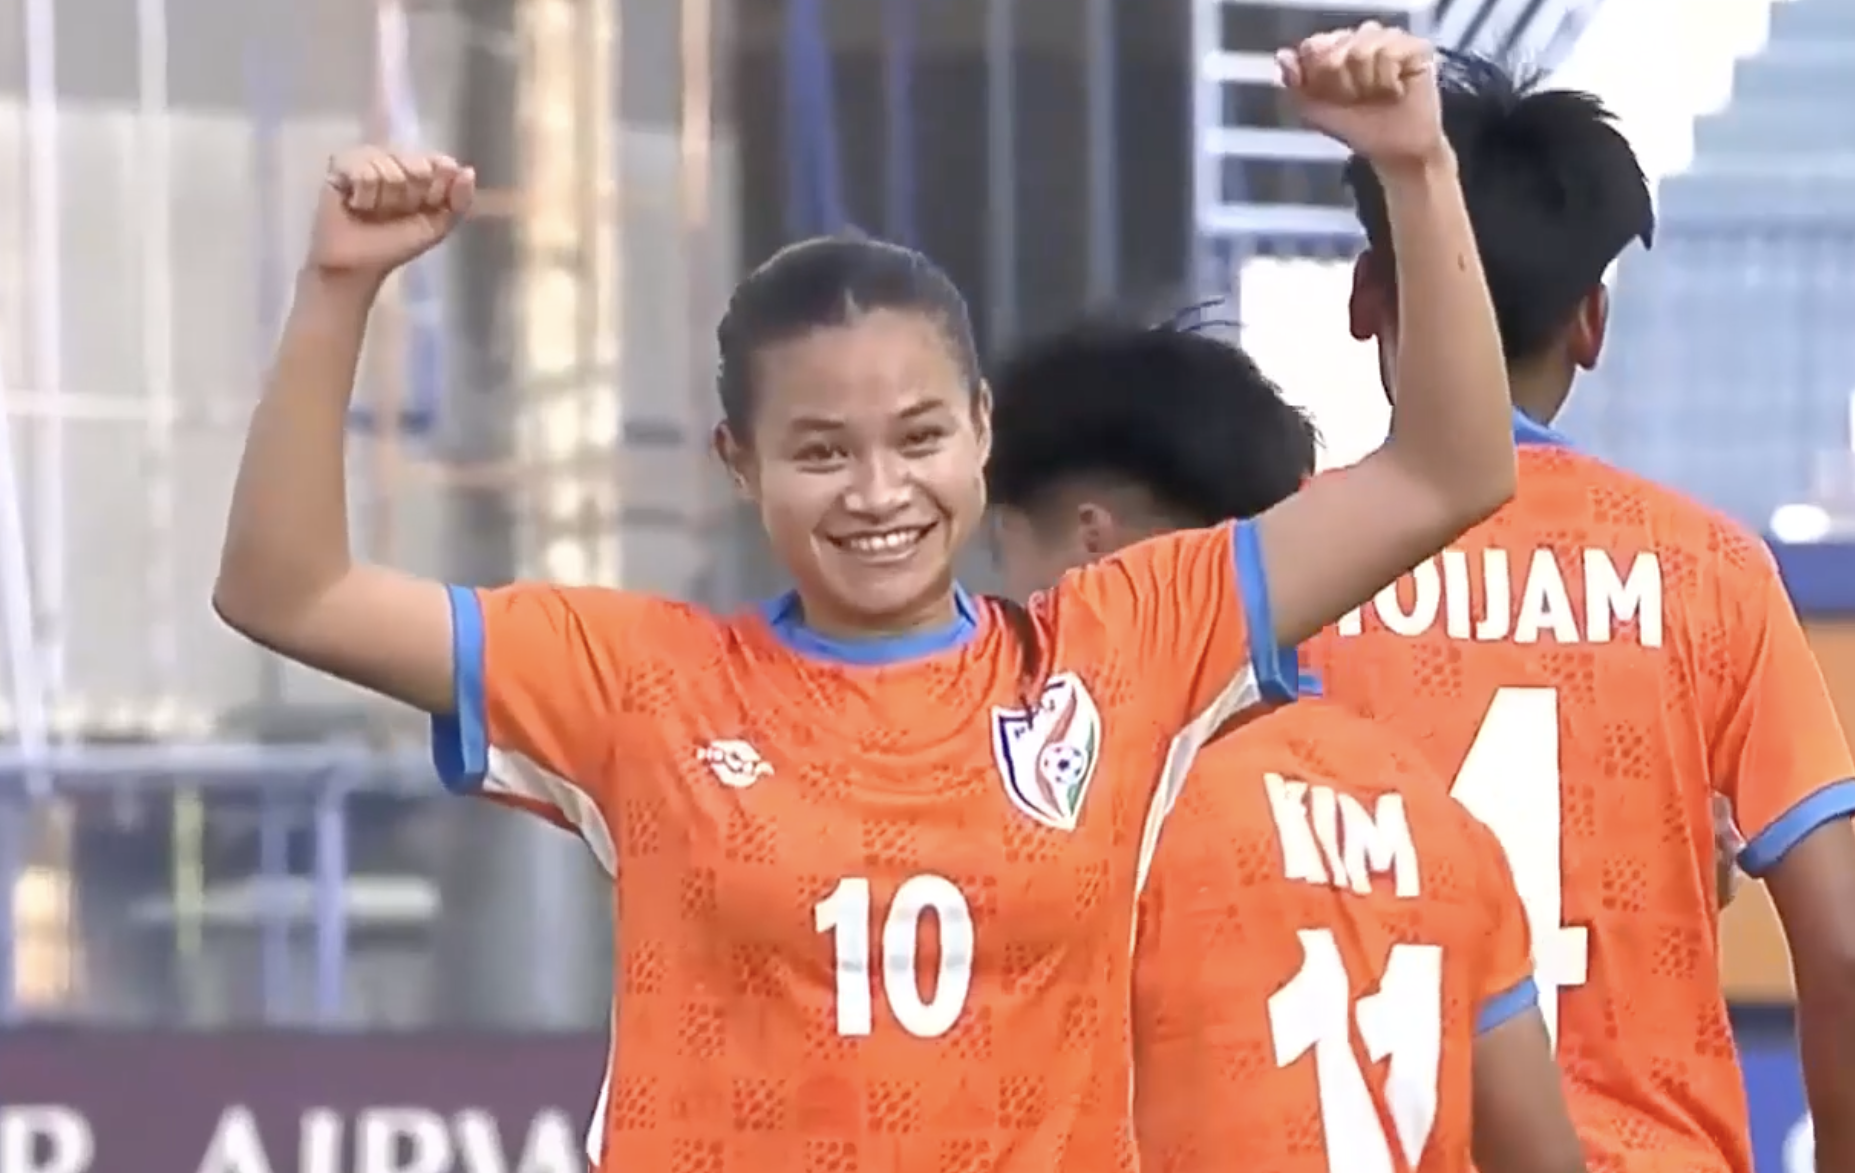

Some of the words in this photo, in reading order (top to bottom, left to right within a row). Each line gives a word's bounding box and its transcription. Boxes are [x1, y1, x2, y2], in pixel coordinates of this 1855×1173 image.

[1338, 548, 1663, 648] OIJAM
[1263, 772, 1420, 897] KIM
[1449, 686, 1588, 1062] 4
[813, 874, 974, 1037] 10
[1267, 928, 1443, 1173] 11
